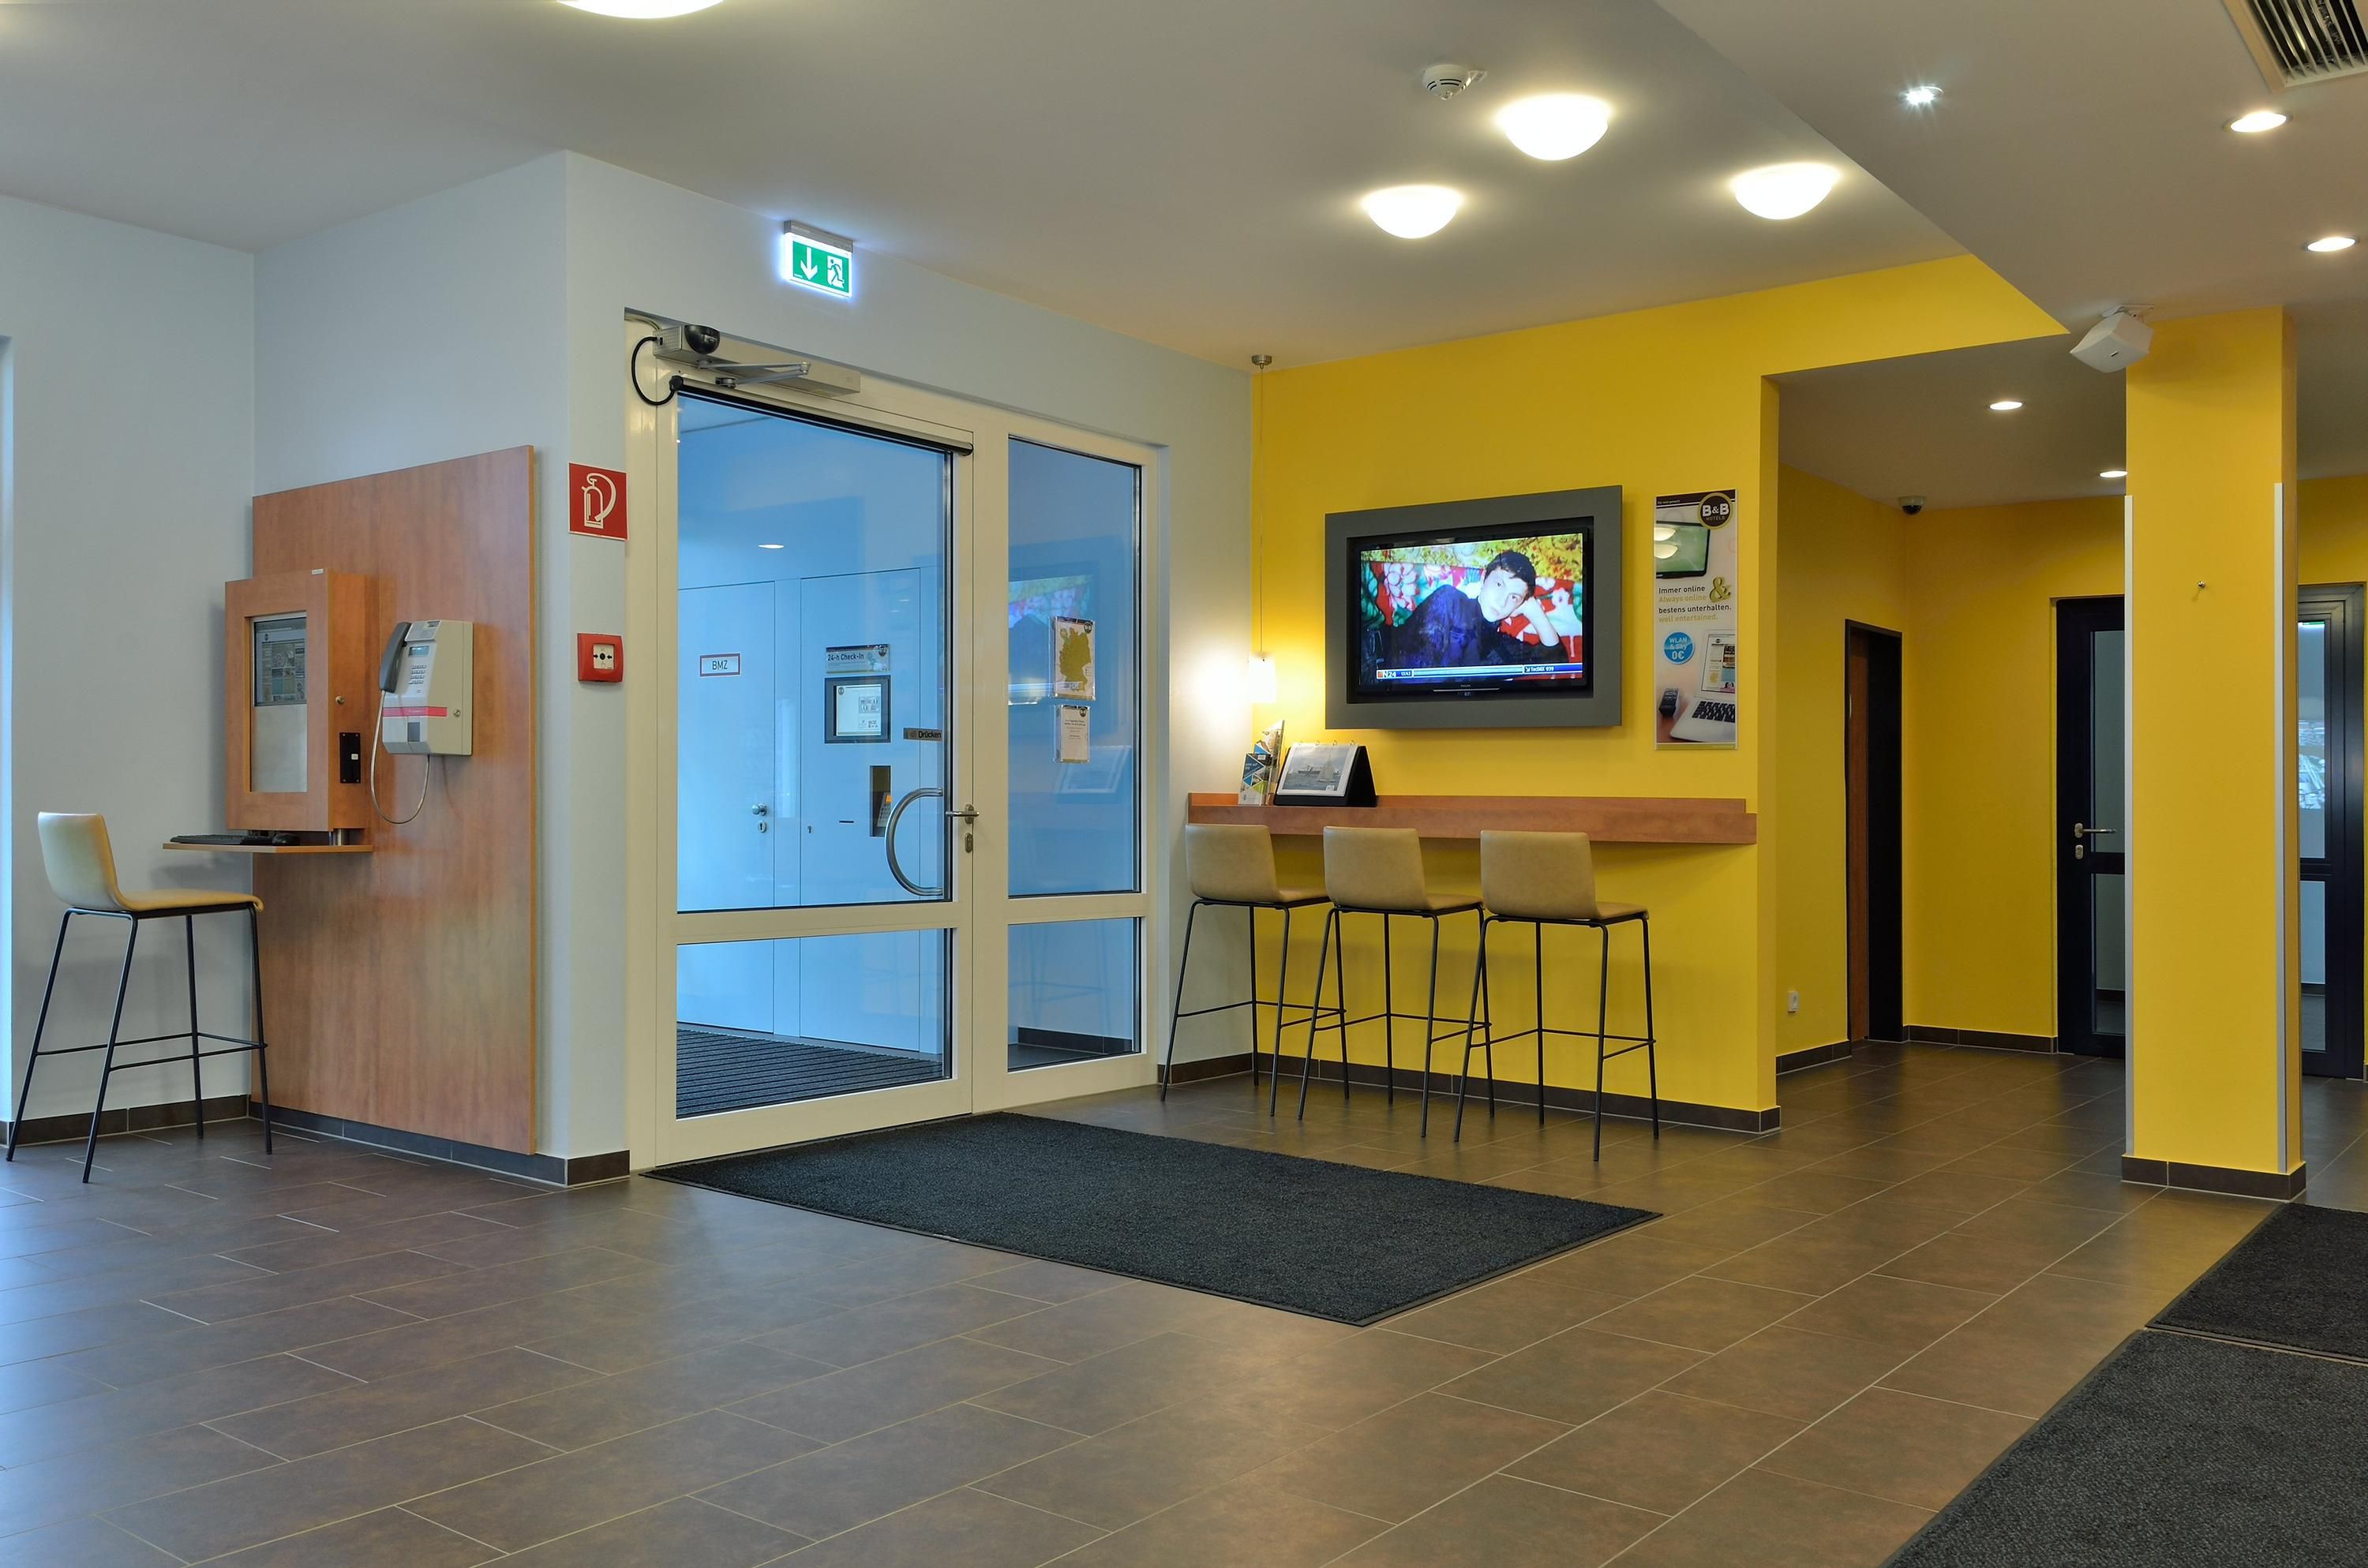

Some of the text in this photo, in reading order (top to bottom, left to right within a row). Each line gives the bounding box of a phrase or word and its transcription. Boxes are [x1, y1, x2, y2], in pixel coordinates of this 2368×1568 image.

[1702, 503, 1729, 517] B&B
[1687, 604, 1732, 612] unterhalten.
[712, 660, 728, 670] BMZ
